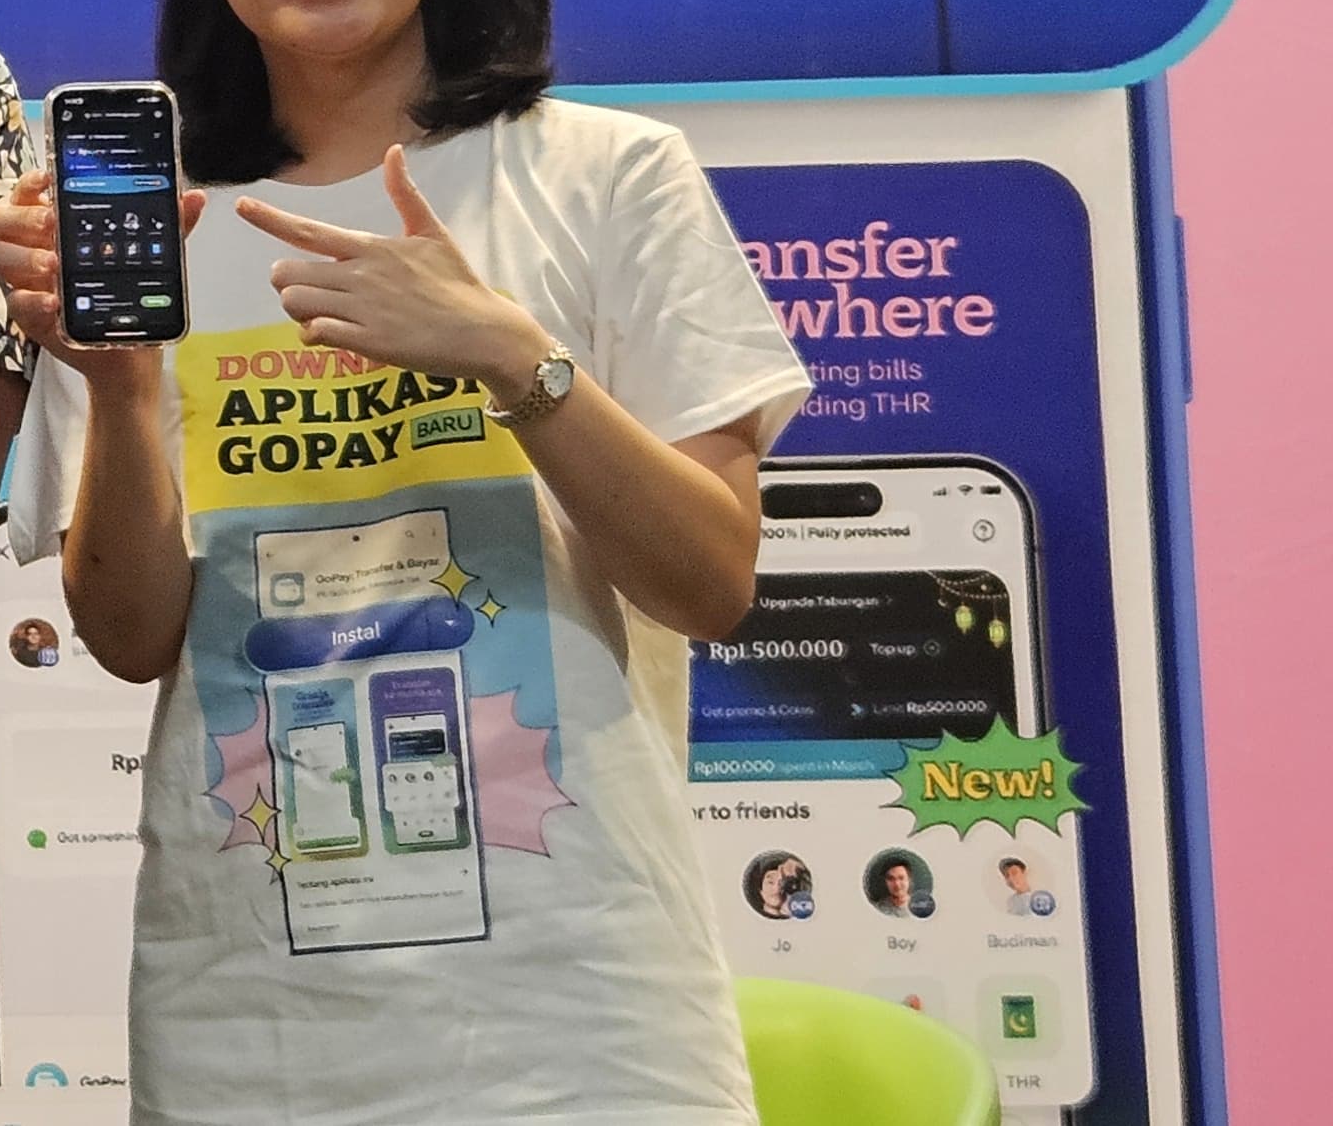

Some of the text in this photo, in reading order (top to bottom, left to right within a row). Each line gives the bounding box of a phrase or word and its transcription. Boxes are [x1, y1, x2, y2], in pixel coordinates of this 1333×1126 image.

[737, 220, 961, 281] ansfer
[771, 281, 997, 339] where
[868, 358, 923, 381] bills
[871, 392, 932, 414] THR
[218, 413, 473, 475] GOPAY BARU
[331, 621, 381, 646] Instal
[919, 758, 1055, 802] New!
[709, 804, 731, 820] to
[734, 801, 811, 820] friends
[887, 936, 918, 953] Boy
[1006, 1074, 1042, 1089] THR
